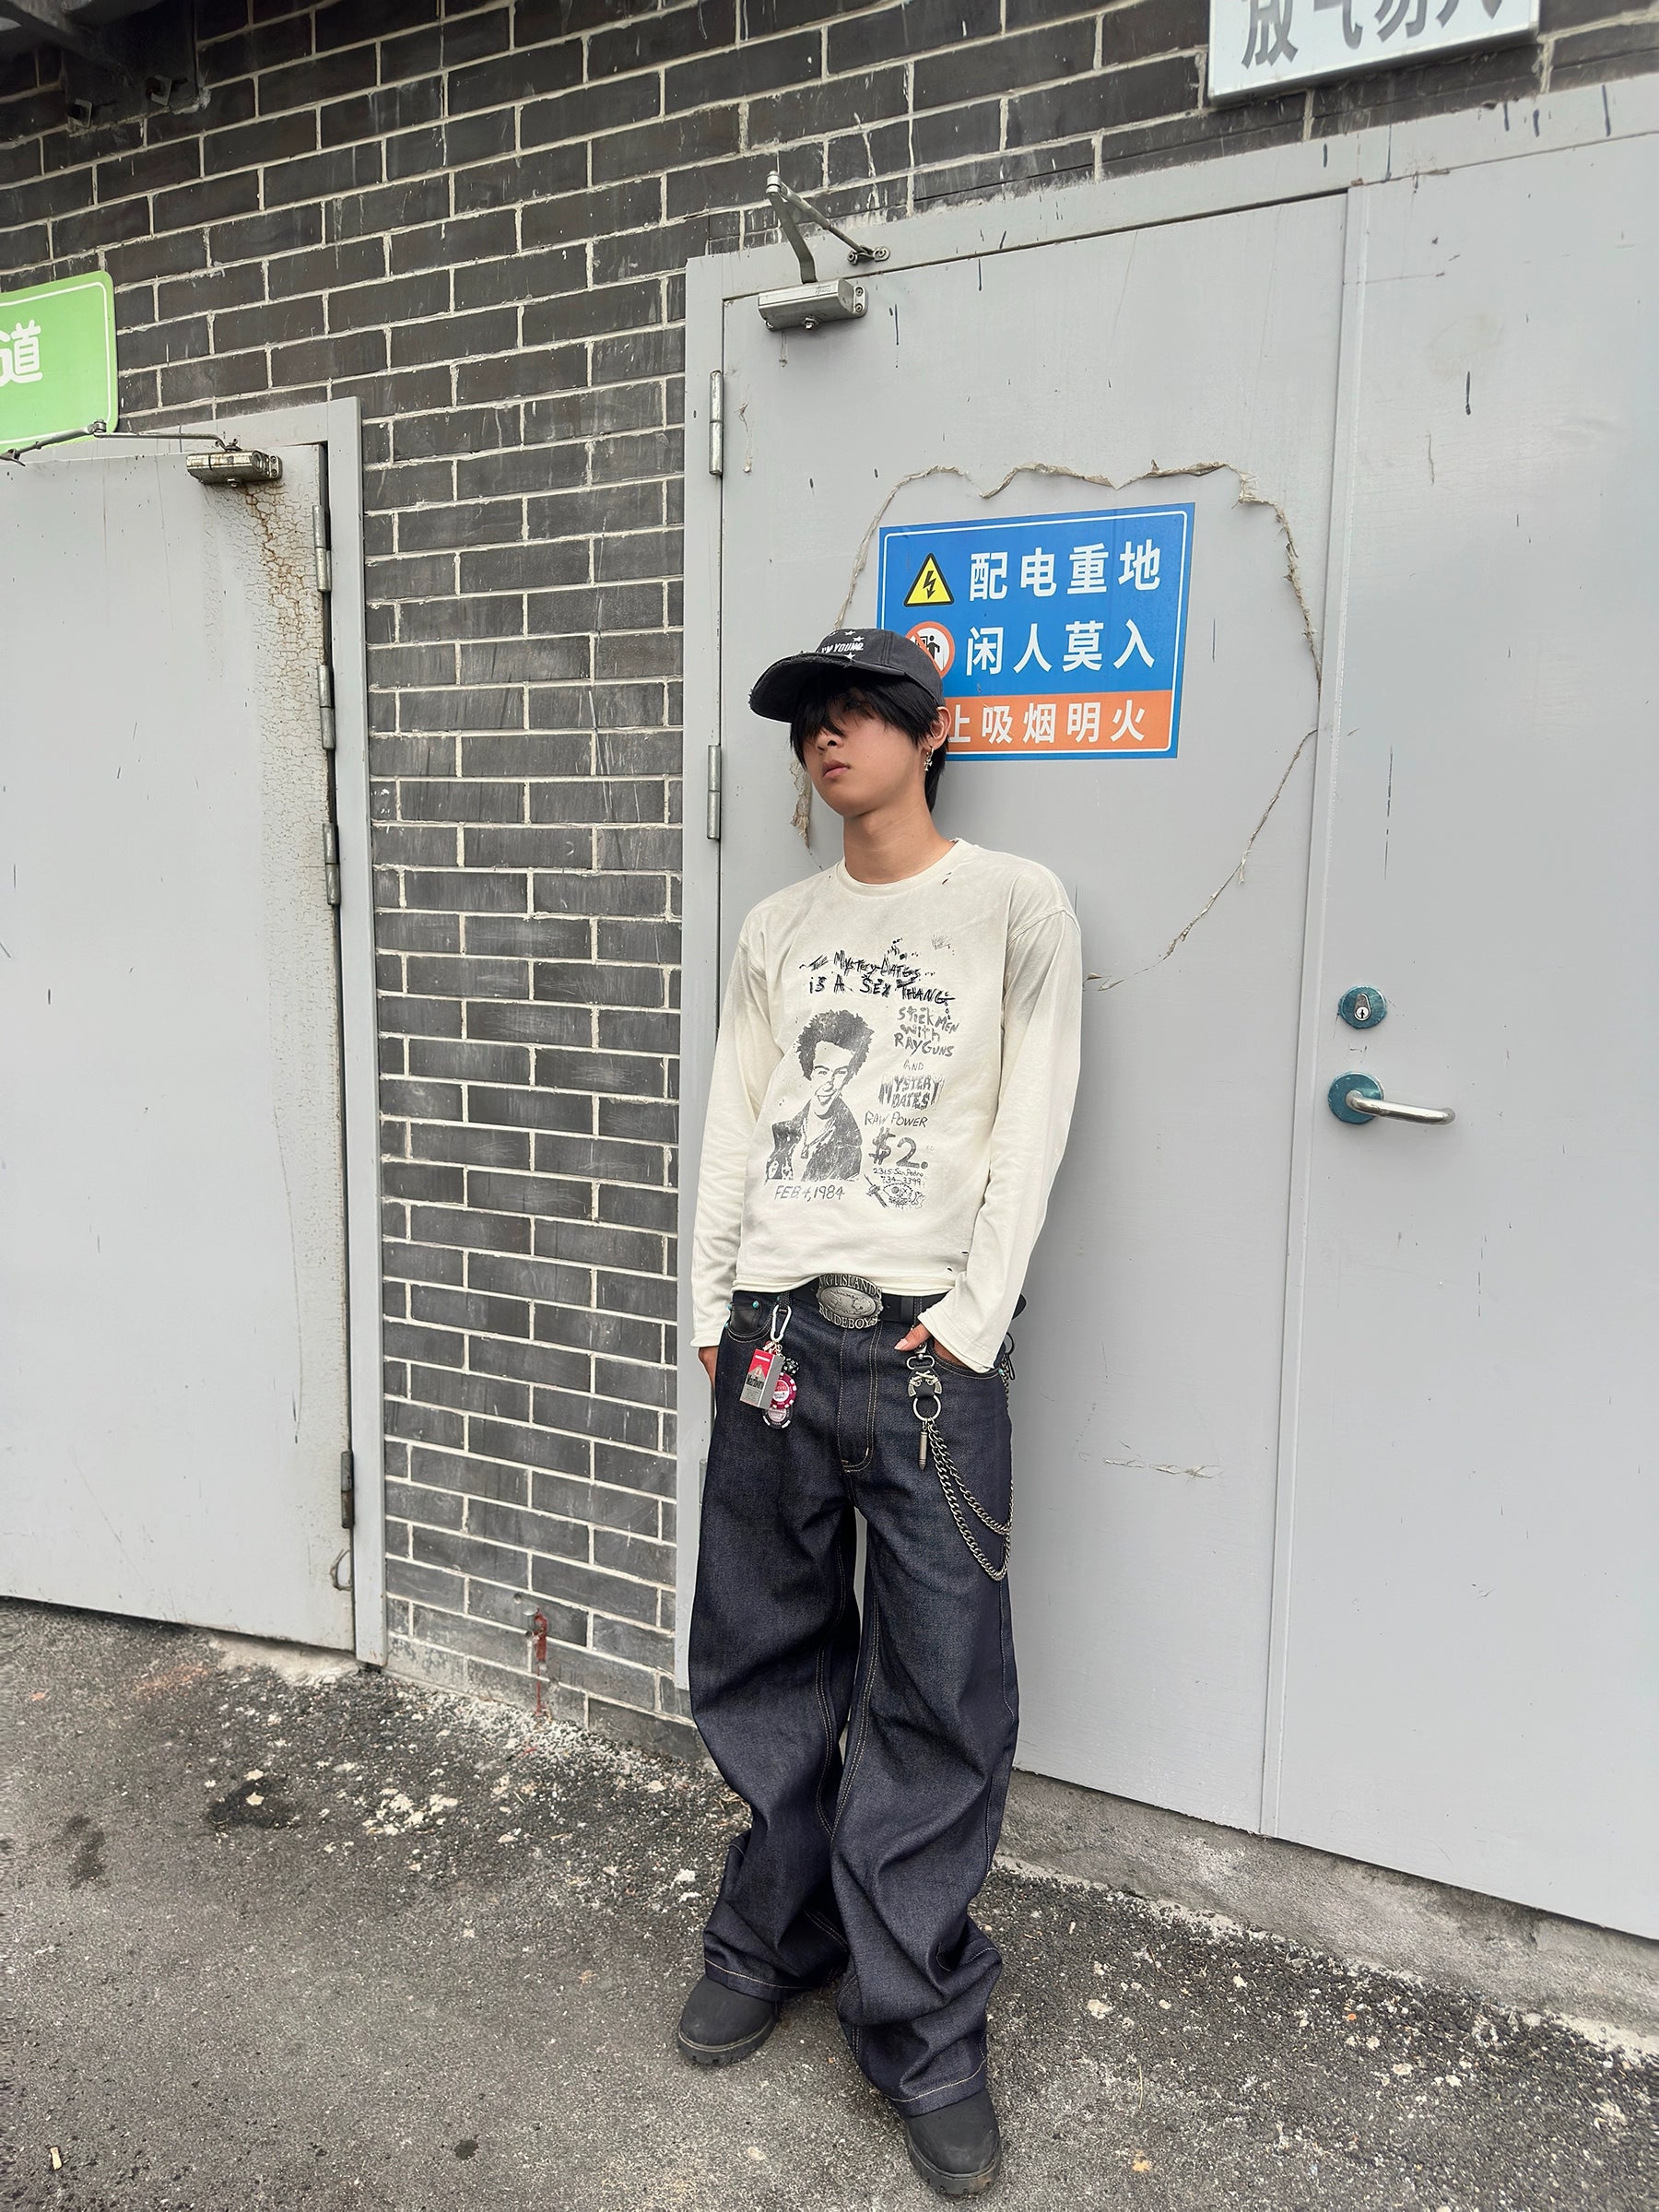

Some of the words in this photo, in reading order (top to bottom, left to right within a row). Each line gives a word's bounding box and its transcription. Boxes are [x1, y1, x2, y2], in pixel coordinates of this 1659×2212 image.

[0, 320, 43, 386] 道
[969, 538, 1161, 602] 配电重地
[966, 618, 1155, 676] 闲人莫入
[903, 1059, 924, 1071] AND
[890, 1111, 928, 1127] POWER
[774, 1185, 801, 1200] FEB
